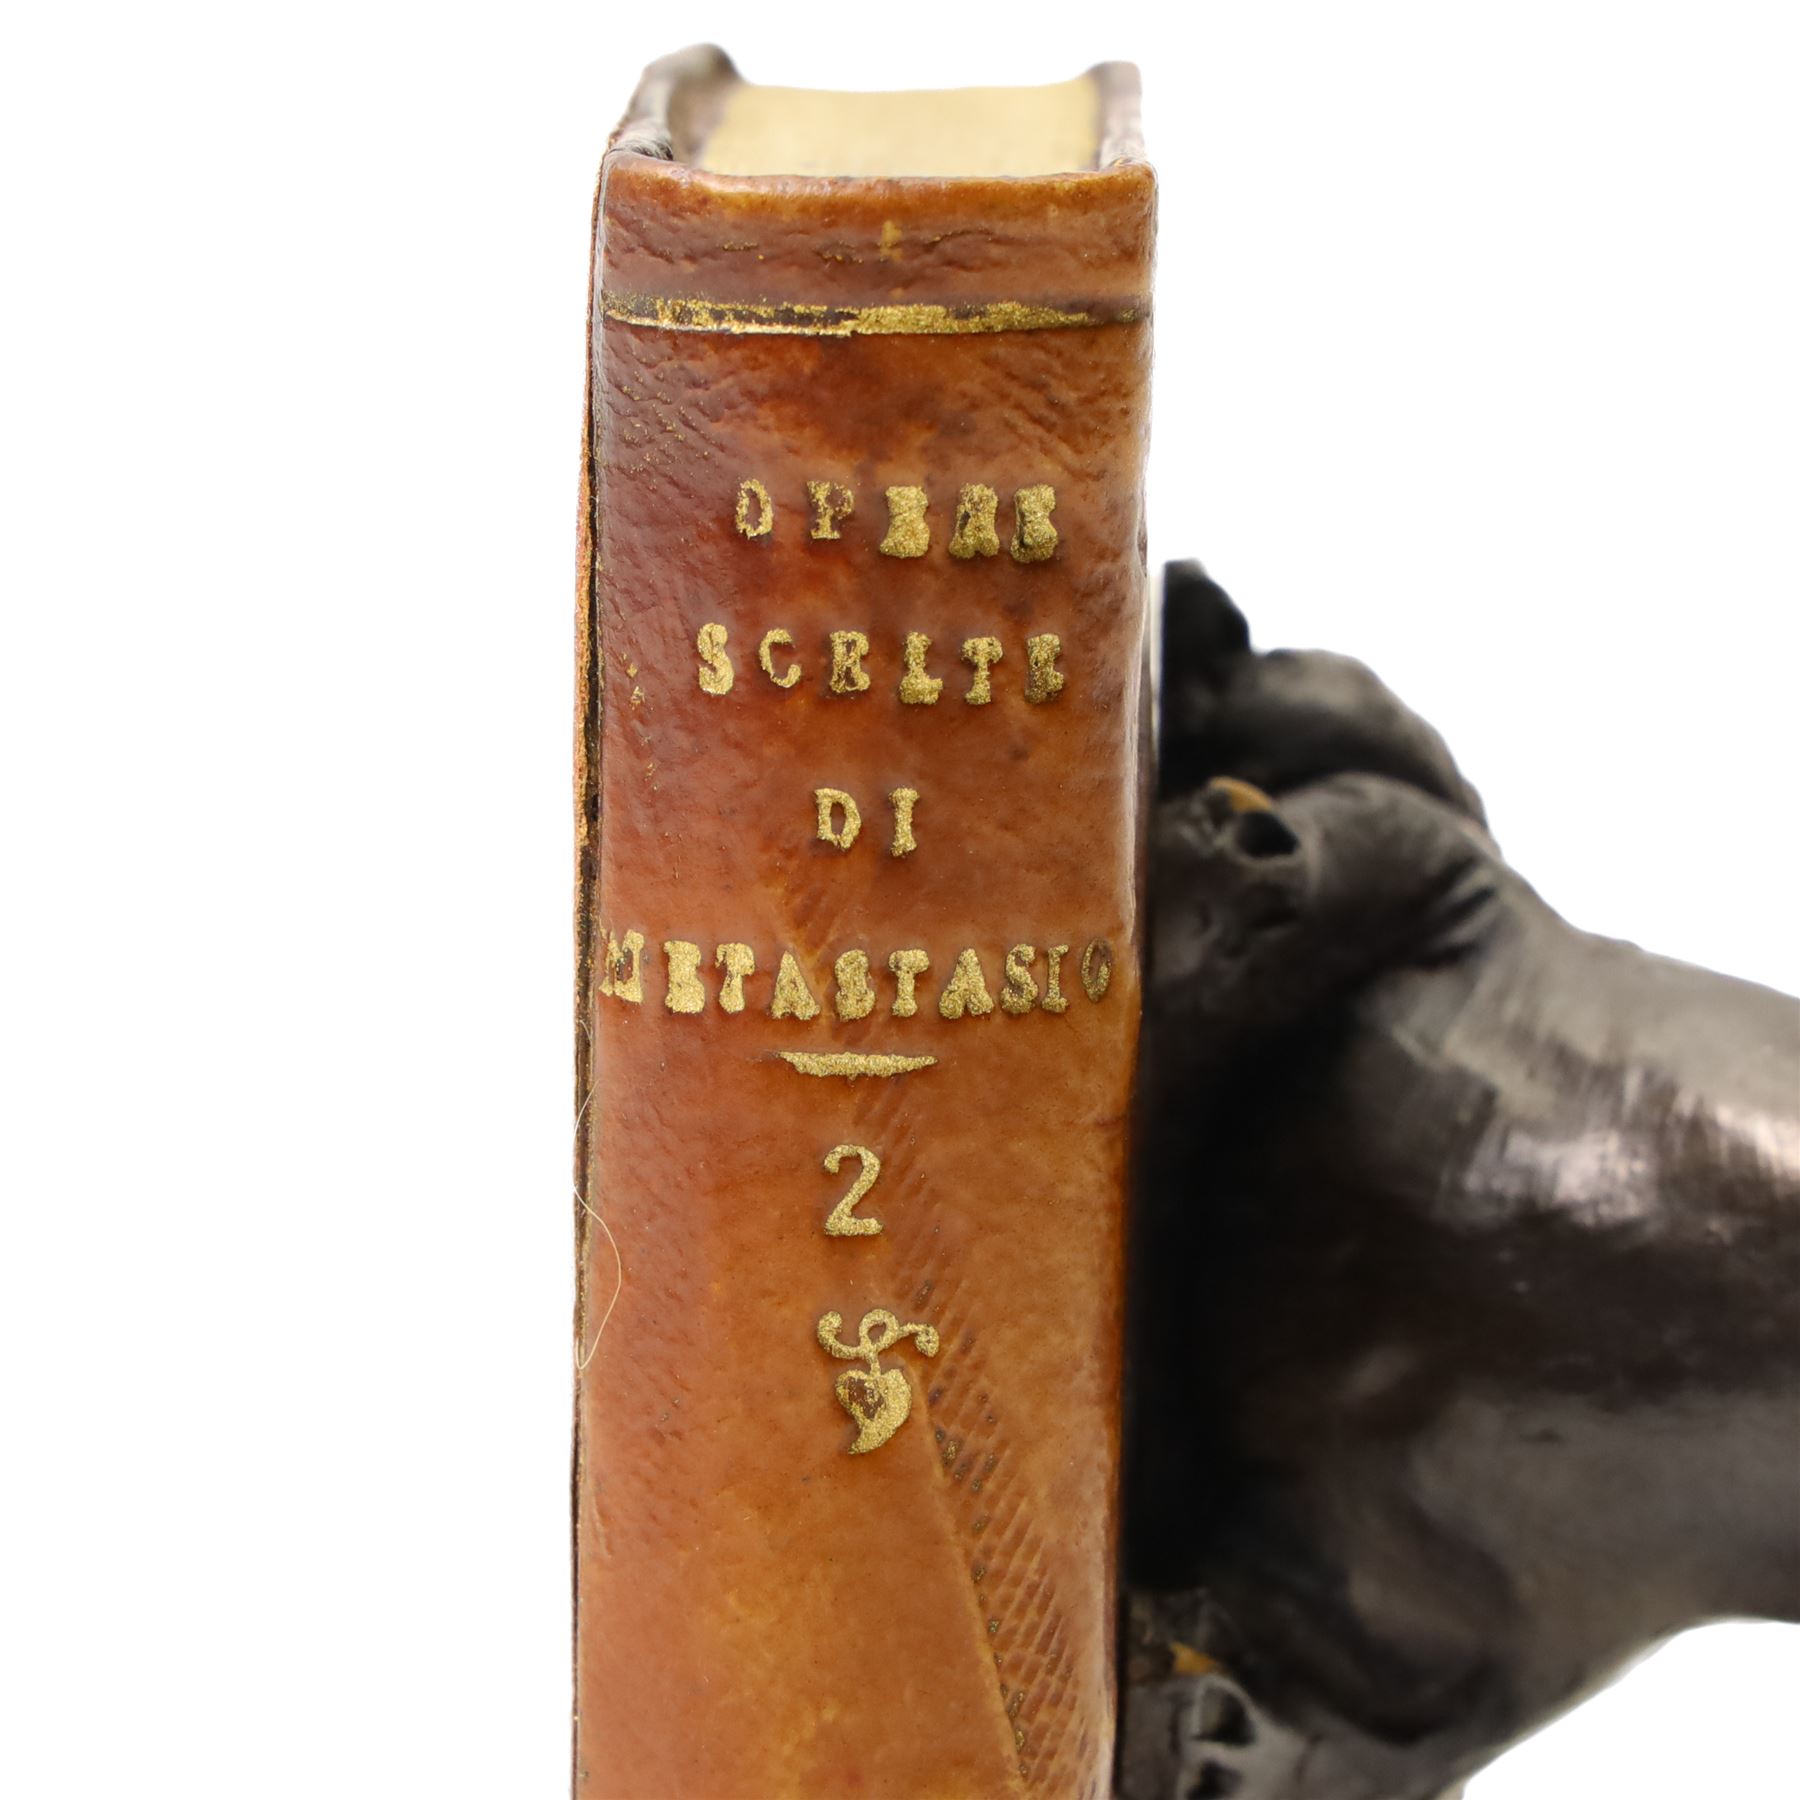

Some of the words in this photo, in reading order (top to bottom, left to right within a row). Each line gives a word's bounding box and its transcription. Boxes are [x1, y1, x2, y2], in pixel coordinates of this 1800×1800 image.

[735, 478, 1058, 562] OPERE
[814, 787, 920, 856] DI
[600, 928, 1113, 1020] METASTASIO
[824, 1144, 883, 1236] 2
